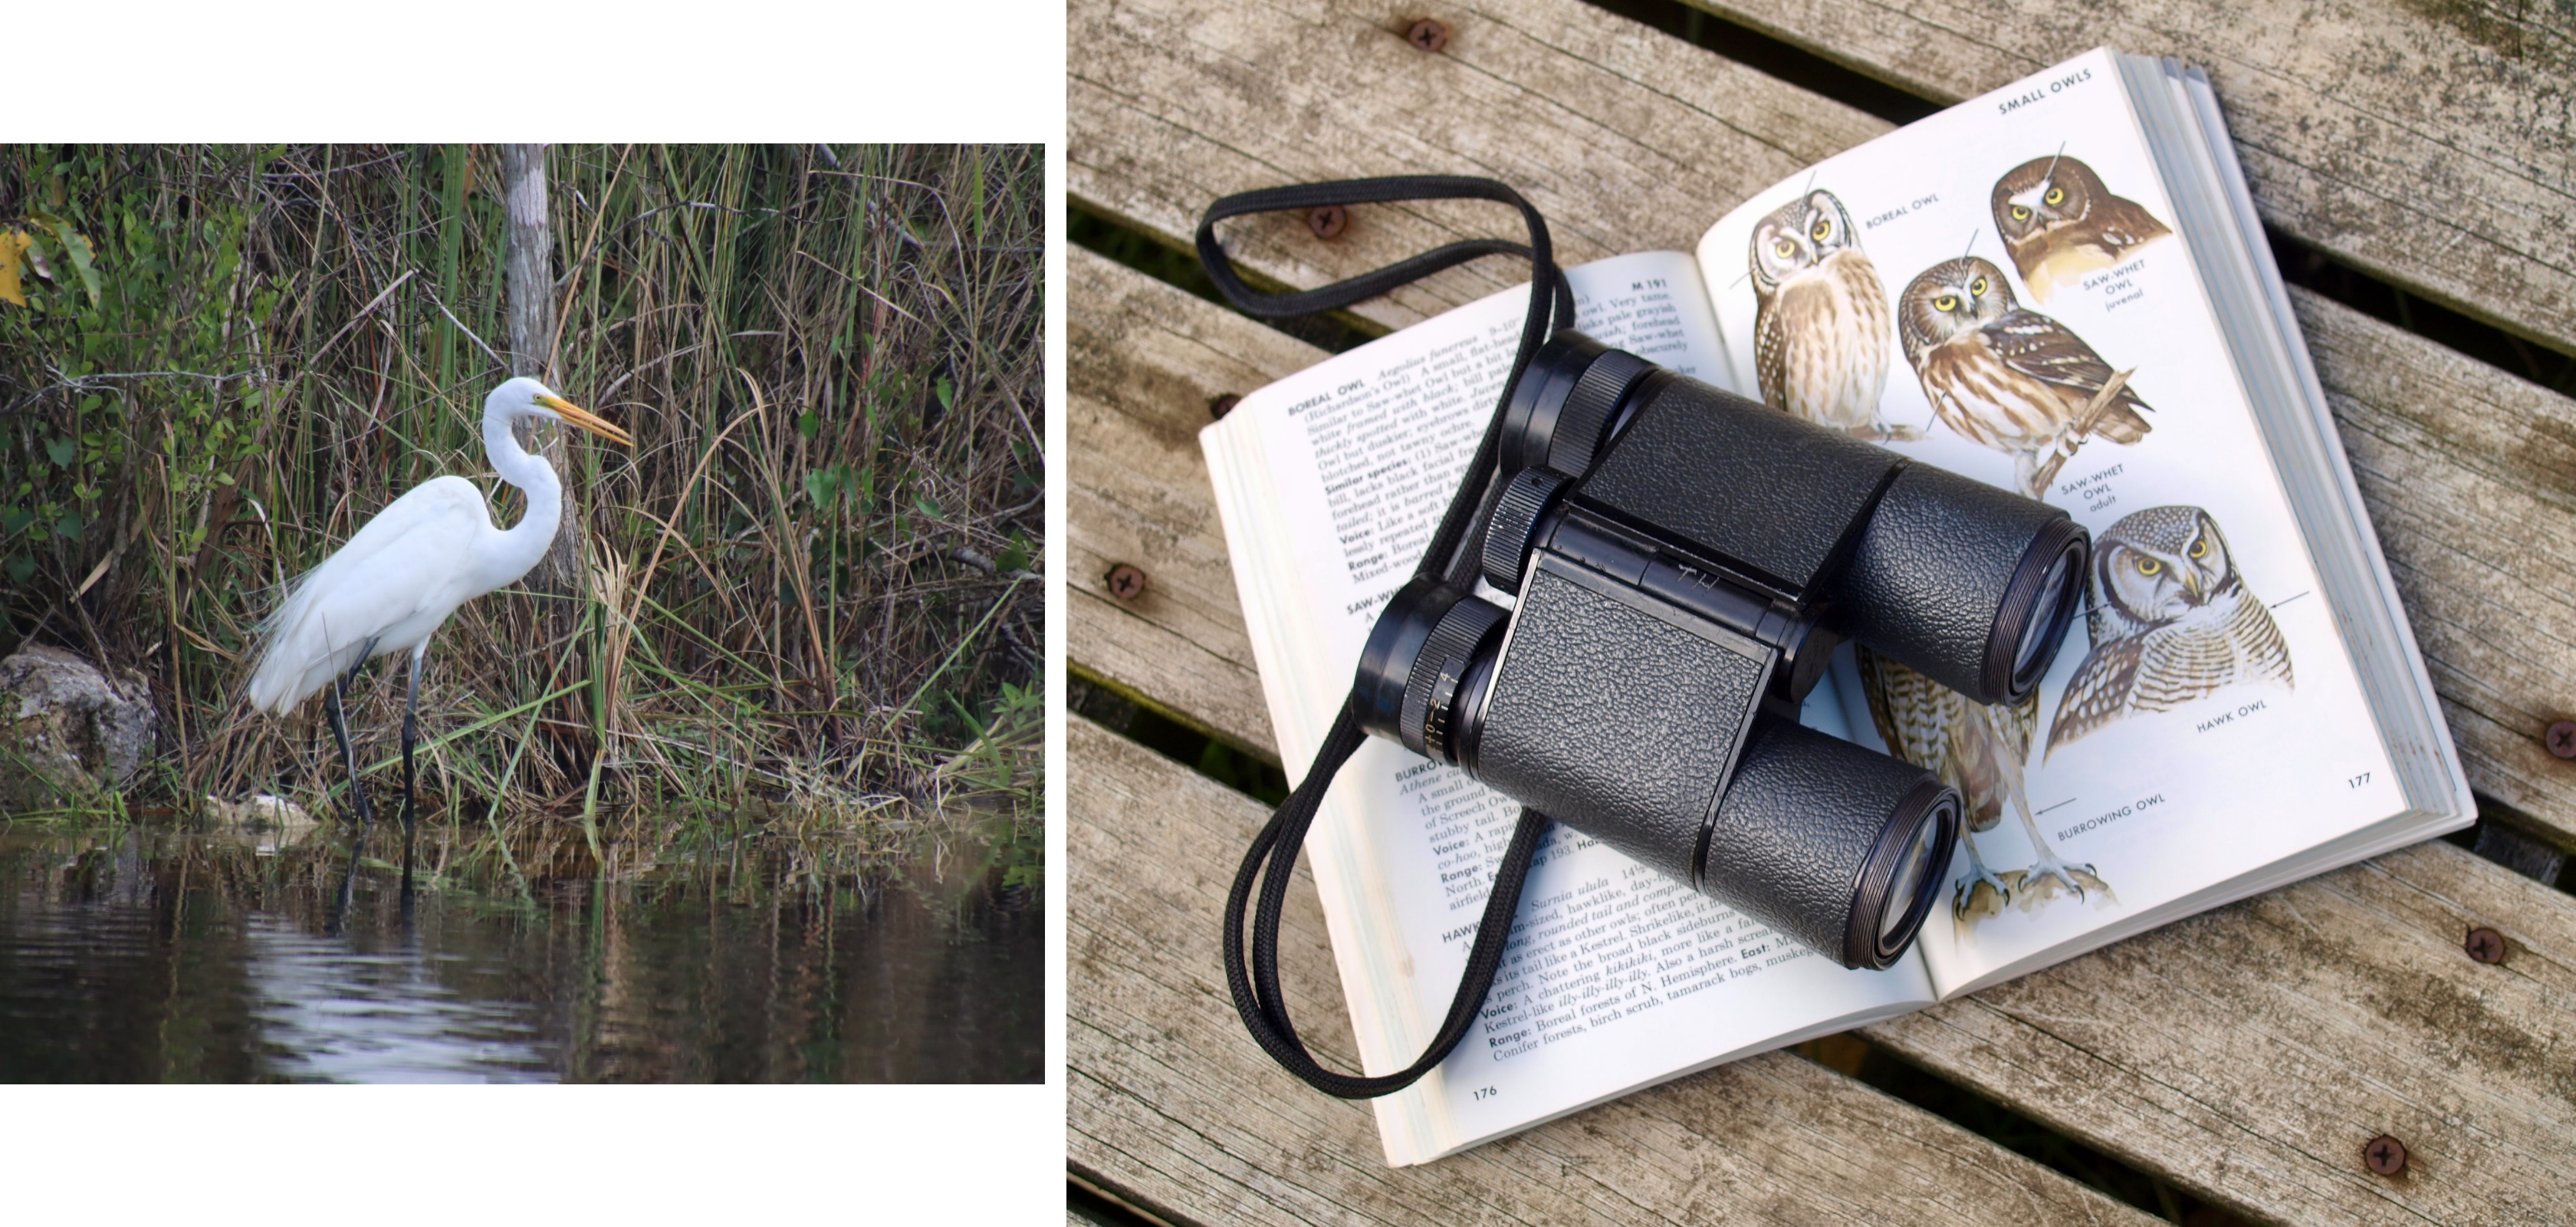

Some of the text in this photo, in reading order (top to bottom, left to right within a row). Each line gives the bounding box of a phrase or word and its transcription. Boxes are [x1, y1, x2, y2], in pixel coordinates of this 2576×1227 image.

[1999, 68, 2092, 114] SMALL OWLS
[1865, 193, 1940, 229] BOREAL OWL
[2083, 258, 2145, 291] SAW-WHET
[2105, 278, 2133, 295] OWL
[2104, 288, 2144, 312] juvenal
[2061, 463, 2124, 495] SAW-WHET
[2083, 482, 2111, 499] OWL
[2089, 495, 2116, 512] adult
[2196, 699, 2267, 732] HAWK OWL
[1400, 775, 1441, 795] Athene
[1431, 779, 1463, 798] small
[2348, 771, 2371, 788] 177
[1421, 804, 1441, 816] the
[1444, 786, 1486, 811] ground
[1440, 801, 1486, 824] Screech
[2058, 793, 2165, 841] BURROWING OWL
[1430, 812, 1498, 843] stubby tail.
[1433, 840, 1469, 855] Voice:
[1438, 851, 1480, 870] co-hoo,
[1441, 865, 1482, 883] Range:
[1563, 829, 1578, 840] w.
[1446, 877, 1484, 896] North.
[1549, 845, 1574, 860] 193.
[1529, 891, 1572, 913] Surnia
[1579, 878, 1608, 895] ulula
[1567, 890, 1625, 914] hawklike,
[1526, 942, 1555, 959] erect
[1559, 938, 1572, 947] as
[1576, 925, 1605, 941] other
[1610, 913, 1641, 929] owls;
[1644, 900, 1675, 916] often
[1538, 913, 1588, 939] rounded
[1592, 905, 1612, 921] tail
[1616, 896, 1639, 912] and
[1497, 981, 1533, 1002] perch.
[1538, 969, 1568, 985] Note
[1574, 960, 1592, 972] the
[1598, 944, 1633, 962] broad
[1638, 932, 1671, 949] black
[1677, 907, 1735, 935] sideburns
[1503, 970, 1520, 982] its
[1521, 960, 1543, 975] tail
[1545, 955, 1566, 967] like
[1580, 932, 1627, 955] Kestrel.
[1629, 910, 1694, 937] Shrikelike,
[1481, 1003, 1516, 1019] Voice:
[1539, 972, 1600, 999] chattering
[1606, 953, 1659, 979] kikikiki,
[1662, 941, 1691, 956] more
[1697, 930, 1720, 943] like
[1484, 1005, 1553, 1034] Kestrel-like
[1559, 971, 1650, 1007] illy-illy-illy-illy.
[1657, 959, 1678, 973] Also
[1698, 940, 1733, 958] harsh
[1489, 1029, 1531, 1048] Range:
[1536, 1010, 1576, 1031] Boreal
[1581, 996, 1620, 1015] forests
[1641, 982, 1656, 994] N.
[1661, 957, 1737, 987] Hemisphere.
[1741, 944, 1770, 959] East:
[1493, 964, 1762, 1061] Conifer forests, birch scrub, tamarack bogs,
[1474, 1085, 1497, 1100] 176
